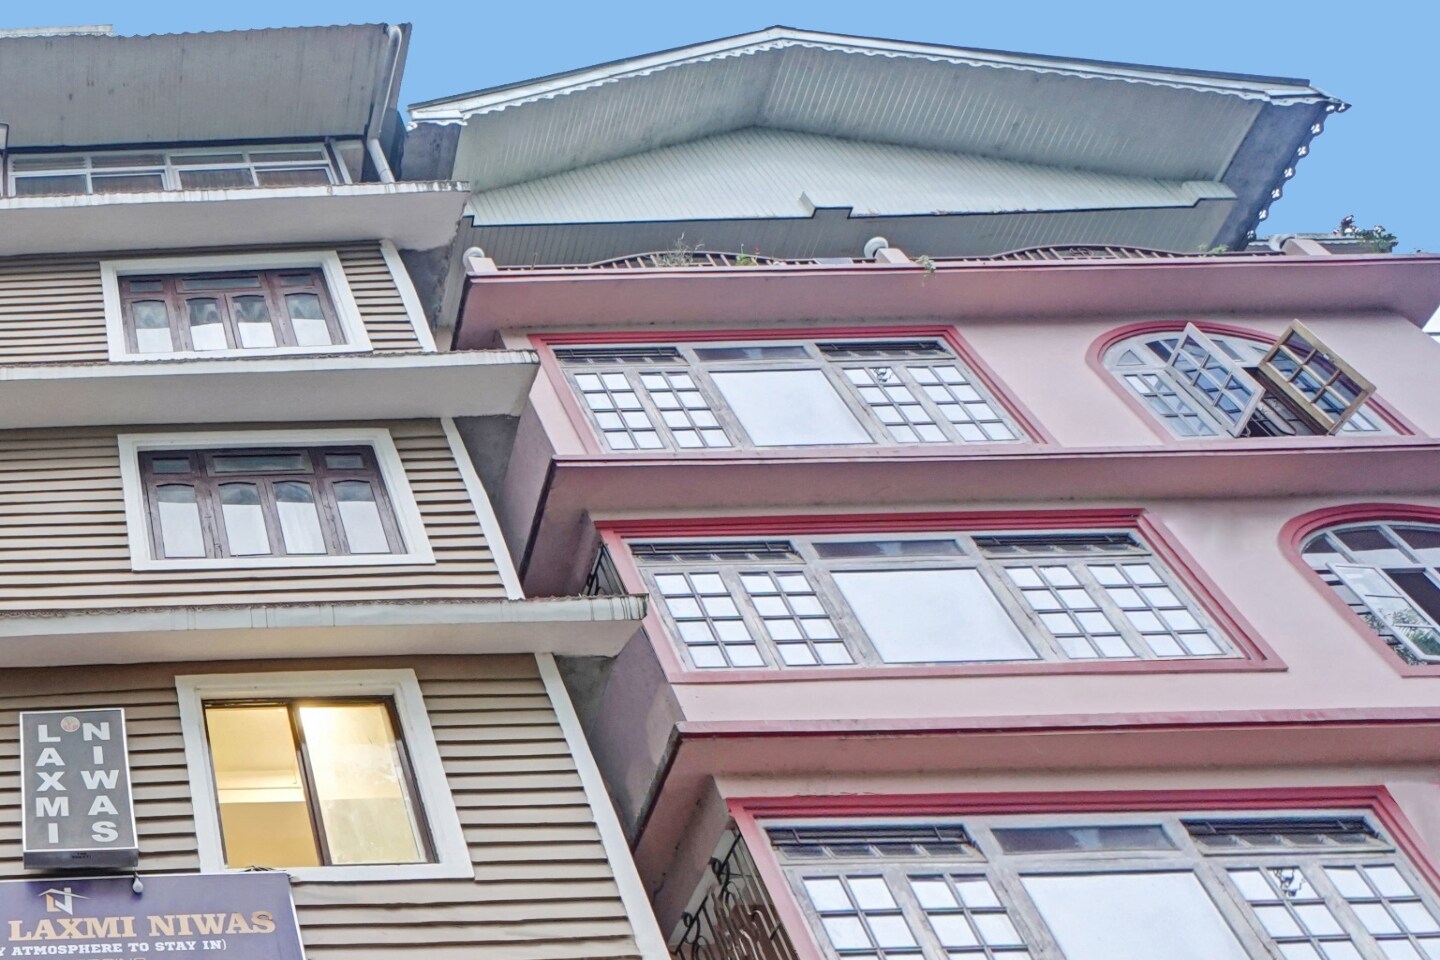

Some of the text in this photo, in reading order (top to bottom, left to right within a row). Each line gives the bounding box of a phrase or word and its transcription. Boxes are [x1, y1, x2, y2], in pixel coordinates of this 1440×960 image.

[35, 724, 69, 843] LAXMI
[80, 722, 119, 842] NIWAS
[8, 916, 137, 942] LAXMI
[147, 911, 276, 937] NIWAS
[12, 942, 123, 956] ATMOSPHERE
[128, 941, 150, 953] TO
[155, 940, 197, 952] STAY
[202, 938, 227, 951] IN)
